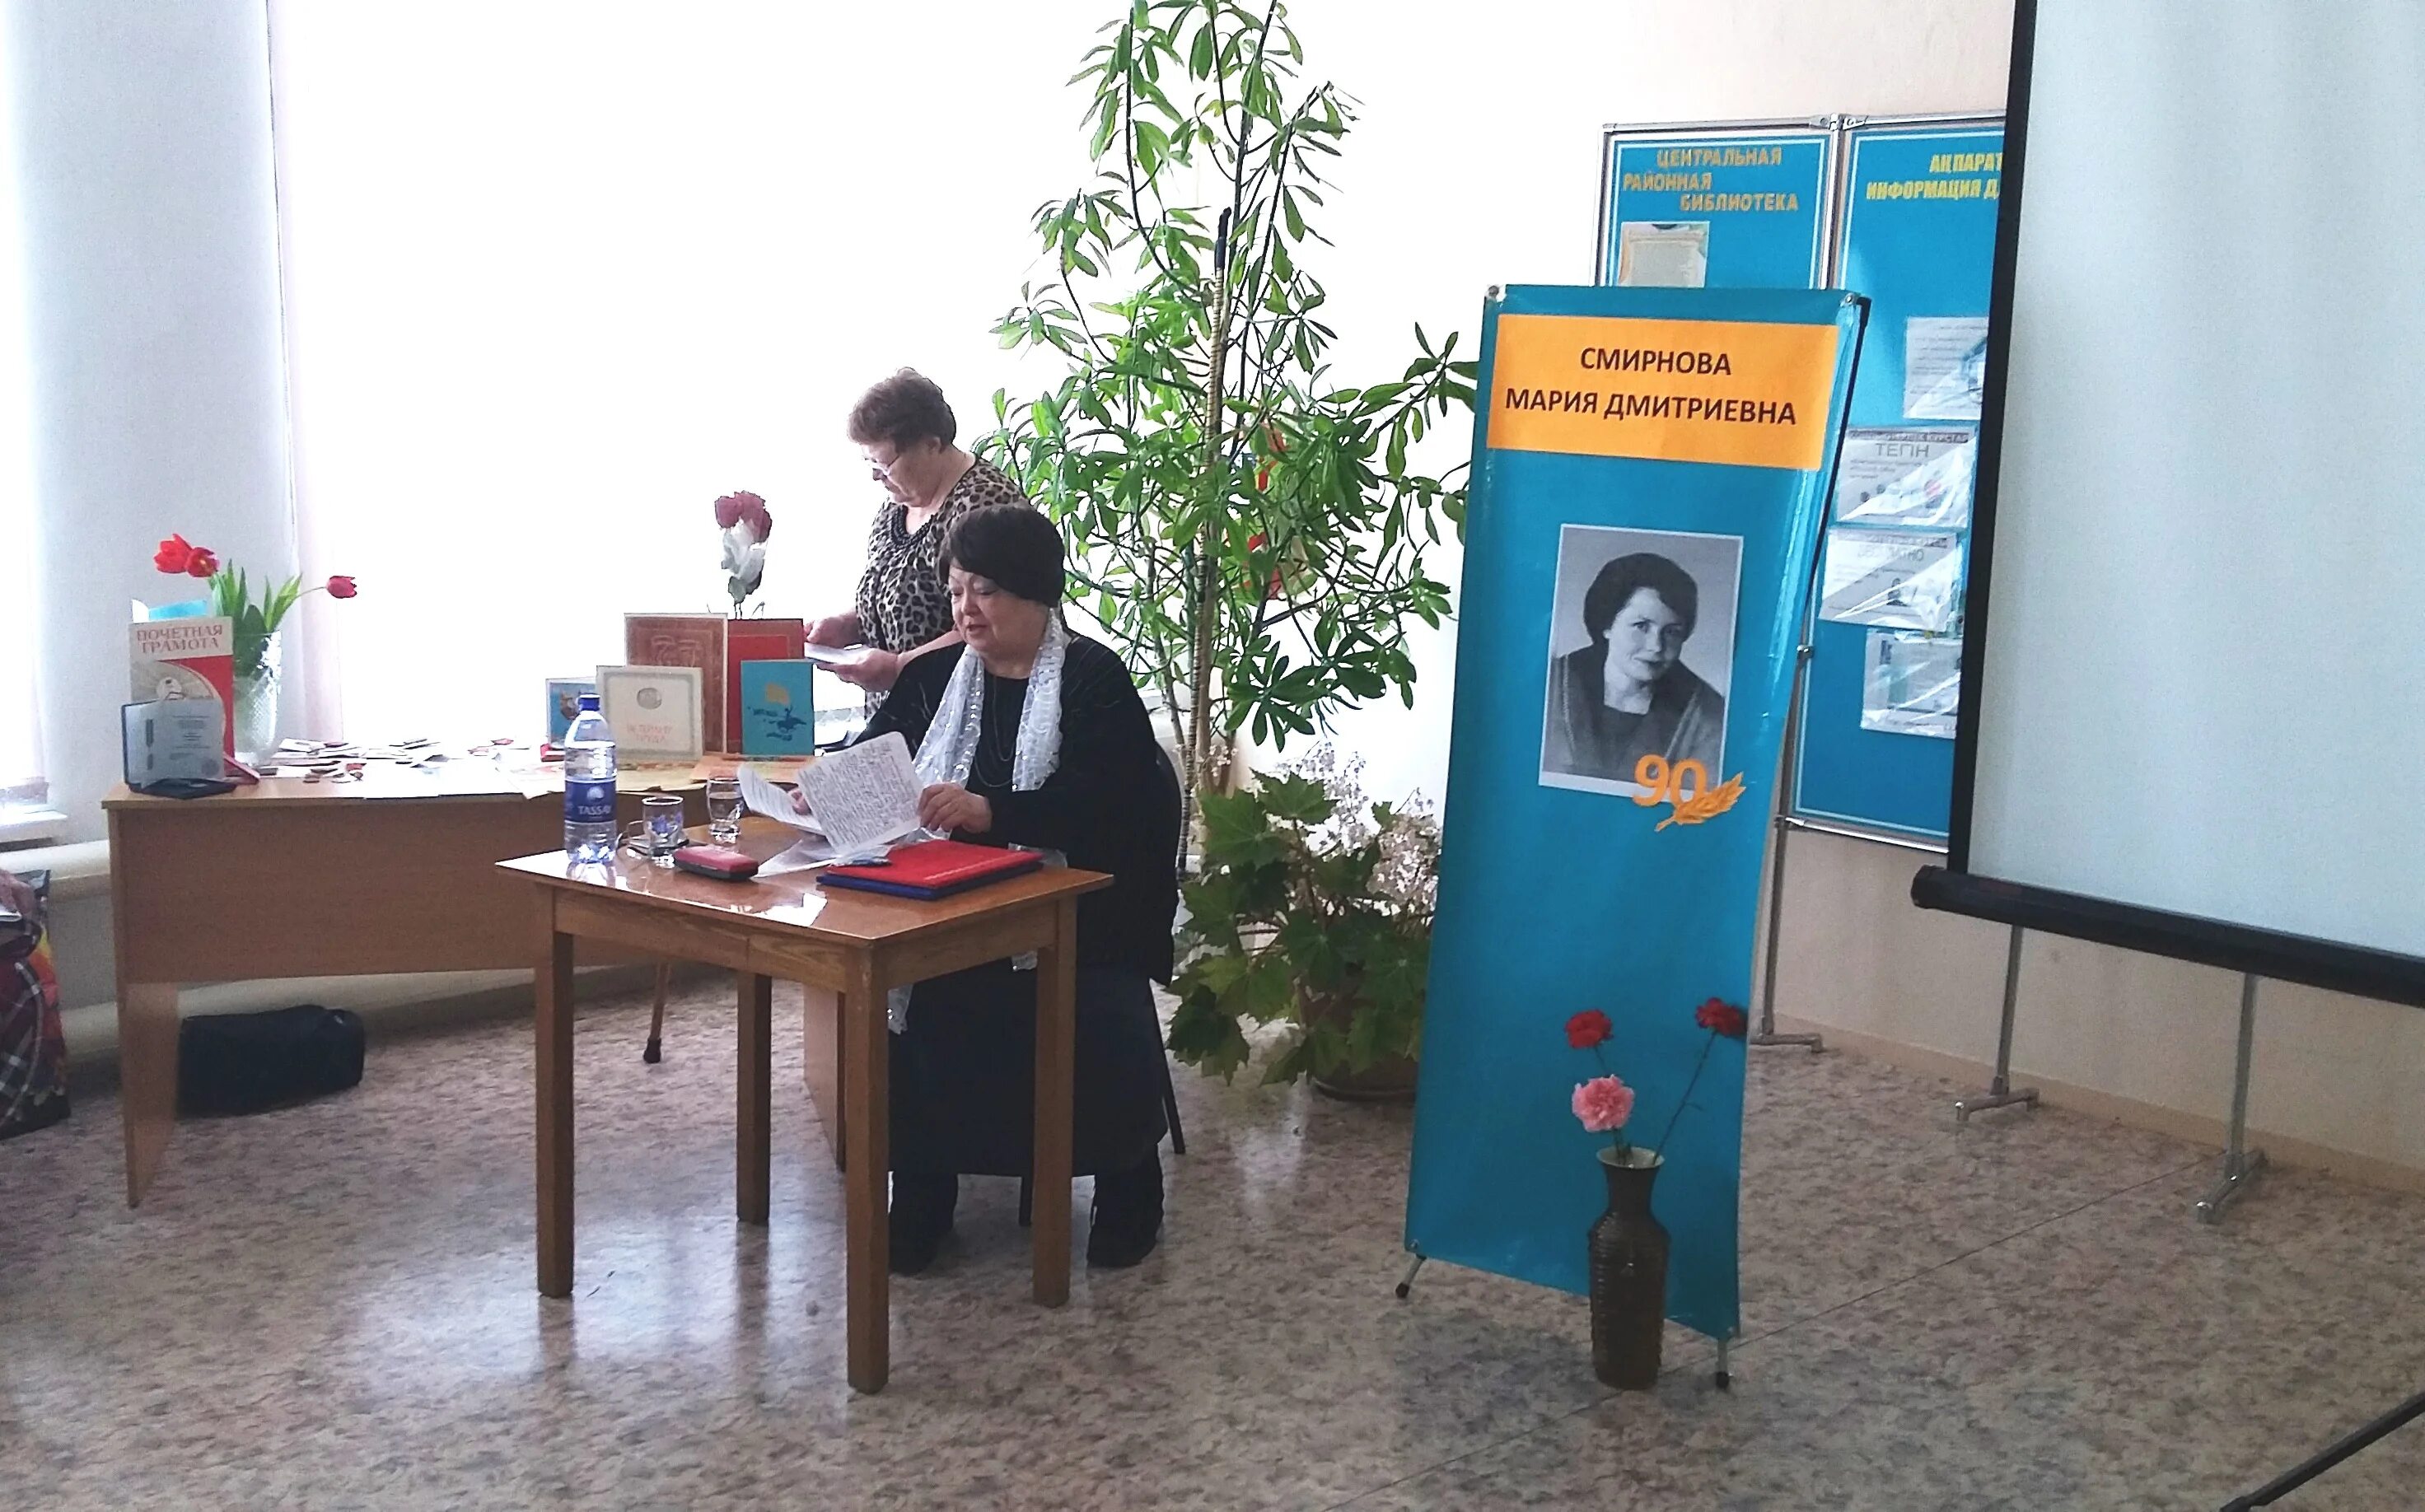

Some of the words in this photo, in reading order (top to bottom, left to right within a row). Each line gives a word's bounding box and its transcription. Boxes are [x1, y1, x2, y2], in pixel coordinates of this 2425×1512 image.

[1656, 147, 1783, 169] ЦЕНТРАЛЬНАЯ
[1623, 170, 1712, 192] РАЙОННАЯ
[1867, 179, 1982, 200] ИНФОРМАЦИЯ
[1680, 193, 1799, 212] БИБЛИОТЕКА
[1580, 348, 1731, 376] СМИРНОВА
[1505, 387, 1598, 414] МАРИЯ
[1603, 392, 1797, 425] ДМИТРИЕВНА
[138, 625, 222, 642] ПОЧЕТНАЯ
[143, 638, 218, 653] ГРАМОТА
[1633, 754, 1708, 810] 90
